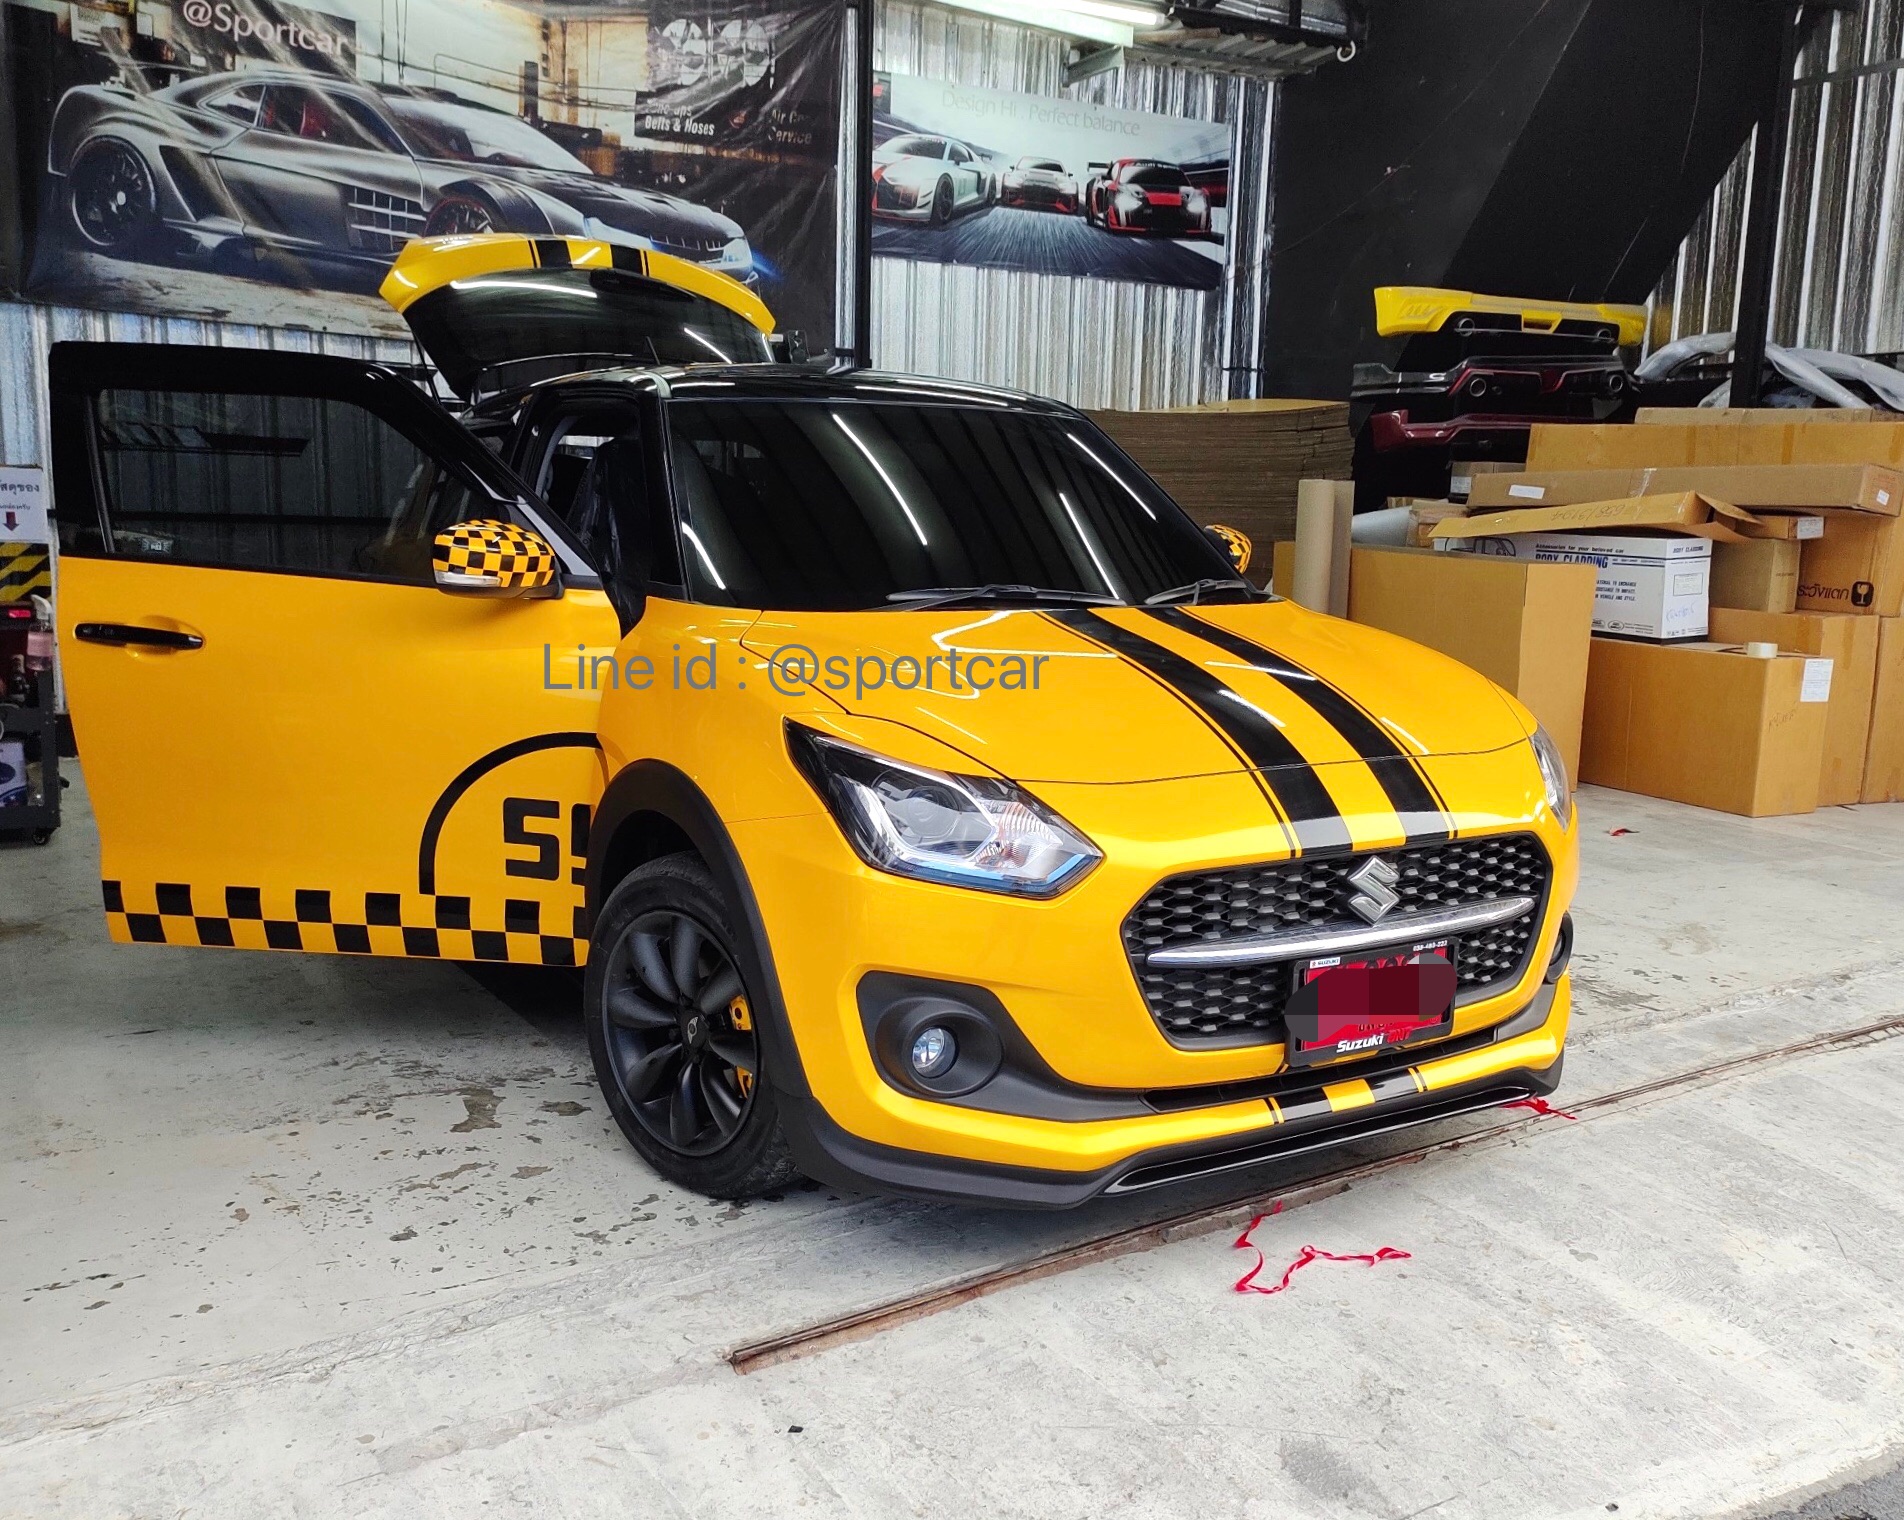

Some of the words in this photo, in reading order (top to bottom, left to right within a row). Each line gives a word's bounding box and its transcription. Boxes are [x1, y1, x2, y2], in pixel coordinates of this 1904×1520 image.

[183, 0, 348, 55] @Sportcar
[943, 91, 996, 115] Design
[1030, 104, 1079, 127] Perfect
[1083, 112, 1140, 136] balance
[645, 115, 671, 131] Belts
[672, 117, 681, 132] &
[684, 118, 715, 135] Hoses
[1563, 554, 1609, 569] CLADDING
[1797, 583, 1850, 600] ระวังแตก
[1317, 958, 1339, 966] SUZUKI
[1336, 1033, 1385, 1053] Suzuki
